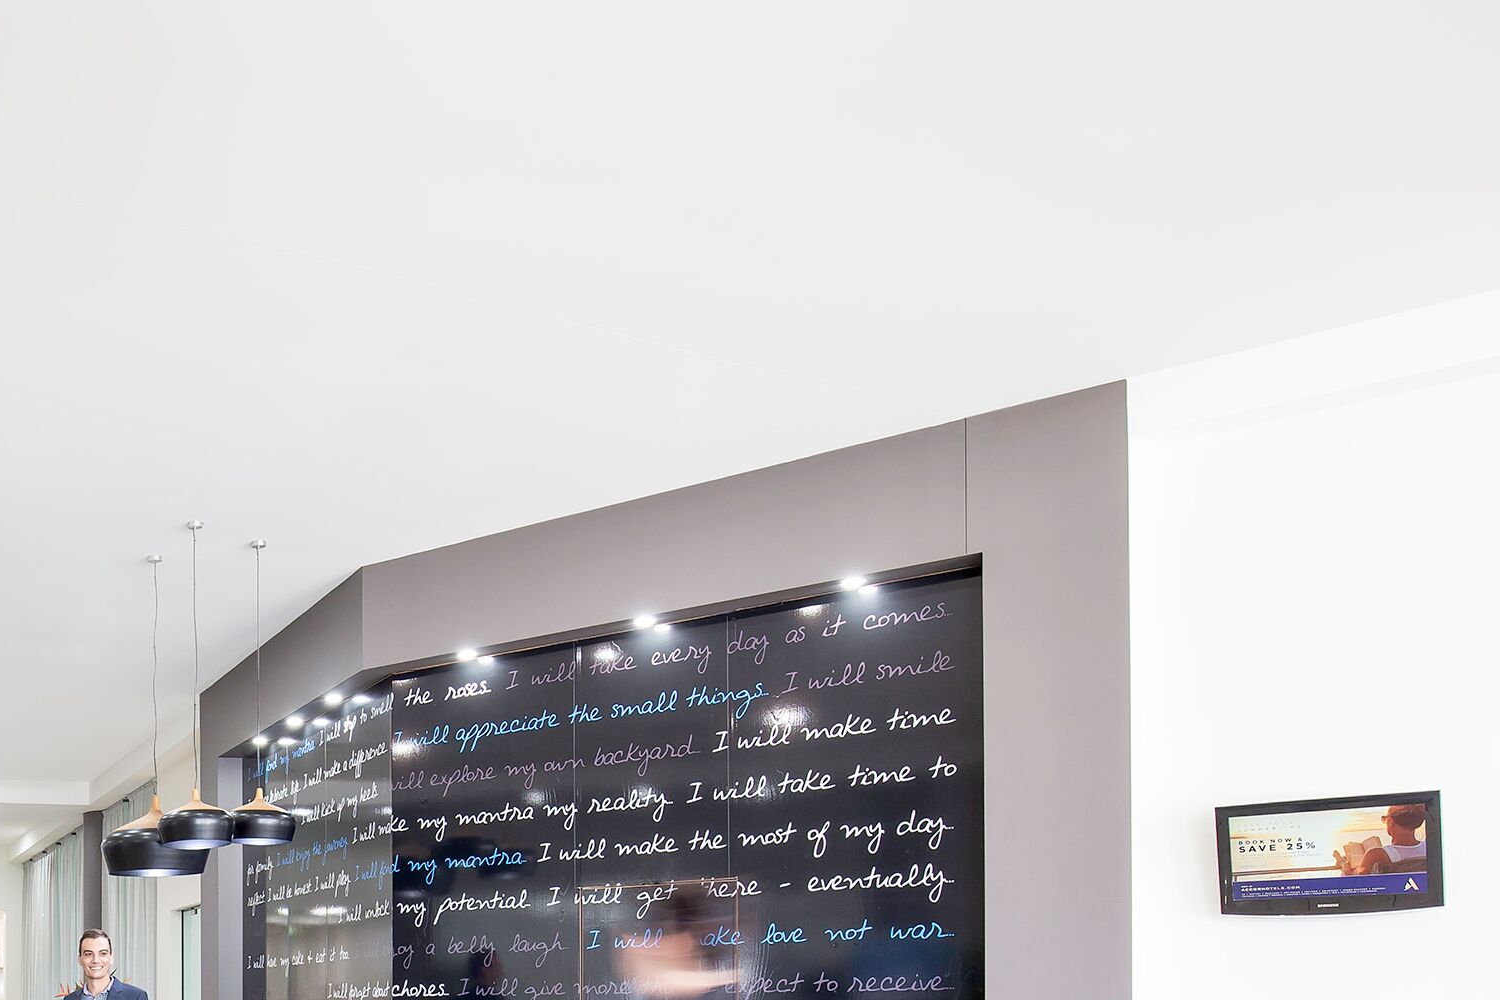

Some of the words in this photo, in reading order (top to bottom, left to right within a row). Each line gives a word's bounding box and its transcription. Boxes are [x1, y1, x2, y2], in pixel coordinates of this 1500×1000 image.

[303, 773, 308, 790] I
[308, 766, 323, 787] will
[324, 760, 342, 779] make
[343, 763, 348, 772] a
[348, 741, 388, 779] difference
[408, 723, 450, 748] will
[455, 709, 561, 754] appreciate
[567, 704, 603, 722] the
[610, 690, 679, 720] small
[782, 671, 799, 695] I
[808, 661, 866, 690] will
[875, 650, 956, 681] smile
[318, 729, 324, 747] I
[326, 722, 341, 742] will
[359, 707, 368, 725] to
[369, 692, 395, 719] smell
[404, 687, 434, 707] the
[505, 670, 520, 691] I
[531, 660, 577, 687] will
[589, 653, 637, 676] take
[651, 645, 712, 675] every
[727, 630, 769, 665] day
[785, 625, 806, 644] as
[821, 613, 847, 638] it
[306, 804, 320, 824] will
[336, 797, 346, 823] up
[347, 796, 358, 818] my
[430, 764, 497, 798] explore
[503, 762, 537, 790] my
[543, 756, 587, 773] own
[712, 730, 730, 753] I
[736, 723, 792, 749] will
[800, 713, 878, 741] make
[886, 707, 957, 731] time
[276, 853, 282, 867] I
[281, 849, 295, 865] will
[311, 841, 323, 856] the
[352, 827, 359, 845] I
[359, 822, 376, 841] will
[377, 814, 410, 836] make
[416, 815, 448, 843] my
[455, 801, 535, 826] mantra
[542, 801, 579, 831] my
[686, 781, 703, 804] I
[712, 774, 767, 801] will
[777, 769, 837, 795] take
[847, 764, 917, 788] time
[928, 755, 959, 780] to
[1238, 844, 1276, 854] SAVE
[1286, 841, 1316, 851] 25%
[267, 888, 273, 903] I
[272, 883, 287, 901] will
[286, 882, 294, 898] be
[313, 877, 320, 893] I
[320, 872, 335, 890] will
[354, 864, 361, 882] I
[361, 861, 378, 881] will
[378, 854, 401, 892] find
[407, 856, 438, 885] my
[536, 841, 552, 864] I
[559, 837, 607, 861] will
[613, 832, 679, 857] make
[687, 829, 728, 851] the
[736, 821, 798, 847] most
[806, 820, 832, 859] of
[839, 821, 886, 855] my
[344, 903, 362, 923] will
[396, 899, 428, 929] my
[546, 886, 561, 907] I
[573, 882, 623, 905] will
[636, 880, 680, 920] get
[246, 955, 252, 970] I
[252, 954, 265, 969] will
[279, 956, 291, 978] my
[329, 946, 337, 962] it
[424, 942, 436, 956] a
[447, 934, 496, 968] belly
[586, 929, 601, 950] I
[614, 928, 664, 949] will
[760, 922, 807, 945] love
[824, 918, 874, 942] not
[327, 982, 333, 999] I
[333, 982, 348, 999] will
[372, 980, 390, 998] about
[457, 977, 471, 996] I
[475, 977, 520, 997] will
[573, 978, 633, 996] more
[813, 971, 839, 992] to
